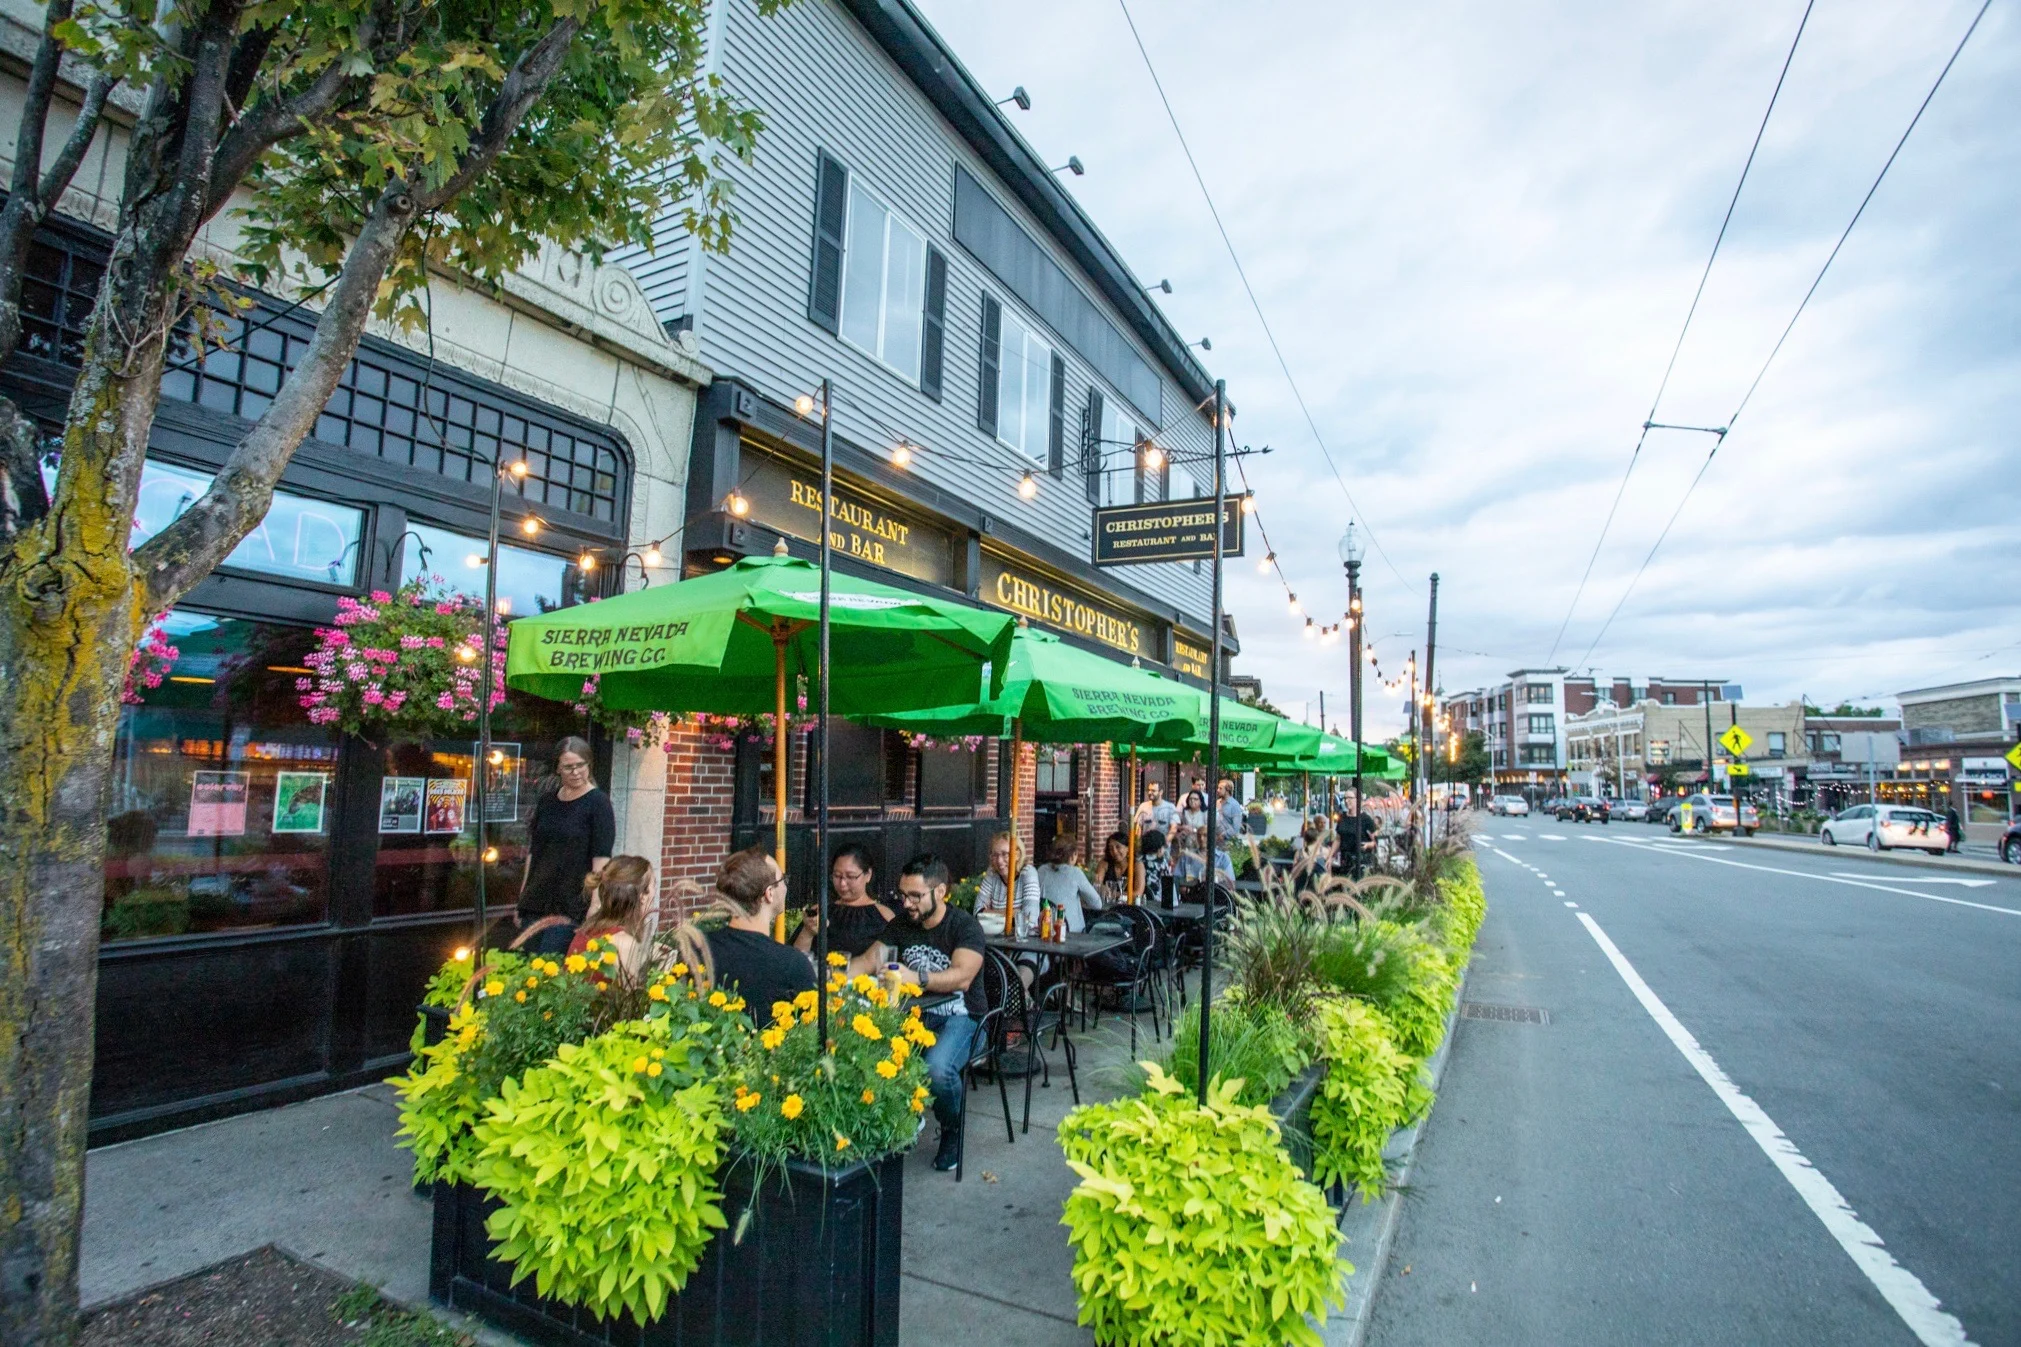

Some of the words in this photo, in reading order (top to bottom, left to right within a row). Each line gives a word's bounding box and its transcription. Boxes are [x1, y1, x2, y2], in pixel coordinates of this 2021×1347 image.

[790, 480, 909, 546] RESTAURANT
[1106, 511, 1230, 533] CHRISTOPHERS
[851, 533, 886, 565] BAR
[1113, 536, 1177, 549] RESTAURANT
[1200, 531, 1216, 542] BA
[997, 572, 1139, 651] CHRISTOPHER'S
[541, 629, 612, 648] SIERRA
[614, 622, 689, 645] NEVADA
[550, 650, 638, 670] BREWING
[1072, 688, 1120, 702] SIERRA
[1122, 694, 1176, 707] NEVADA
[1087, 704, 1147, 720] BREWING
[1222, 720, 1258, 732] NEVADA
